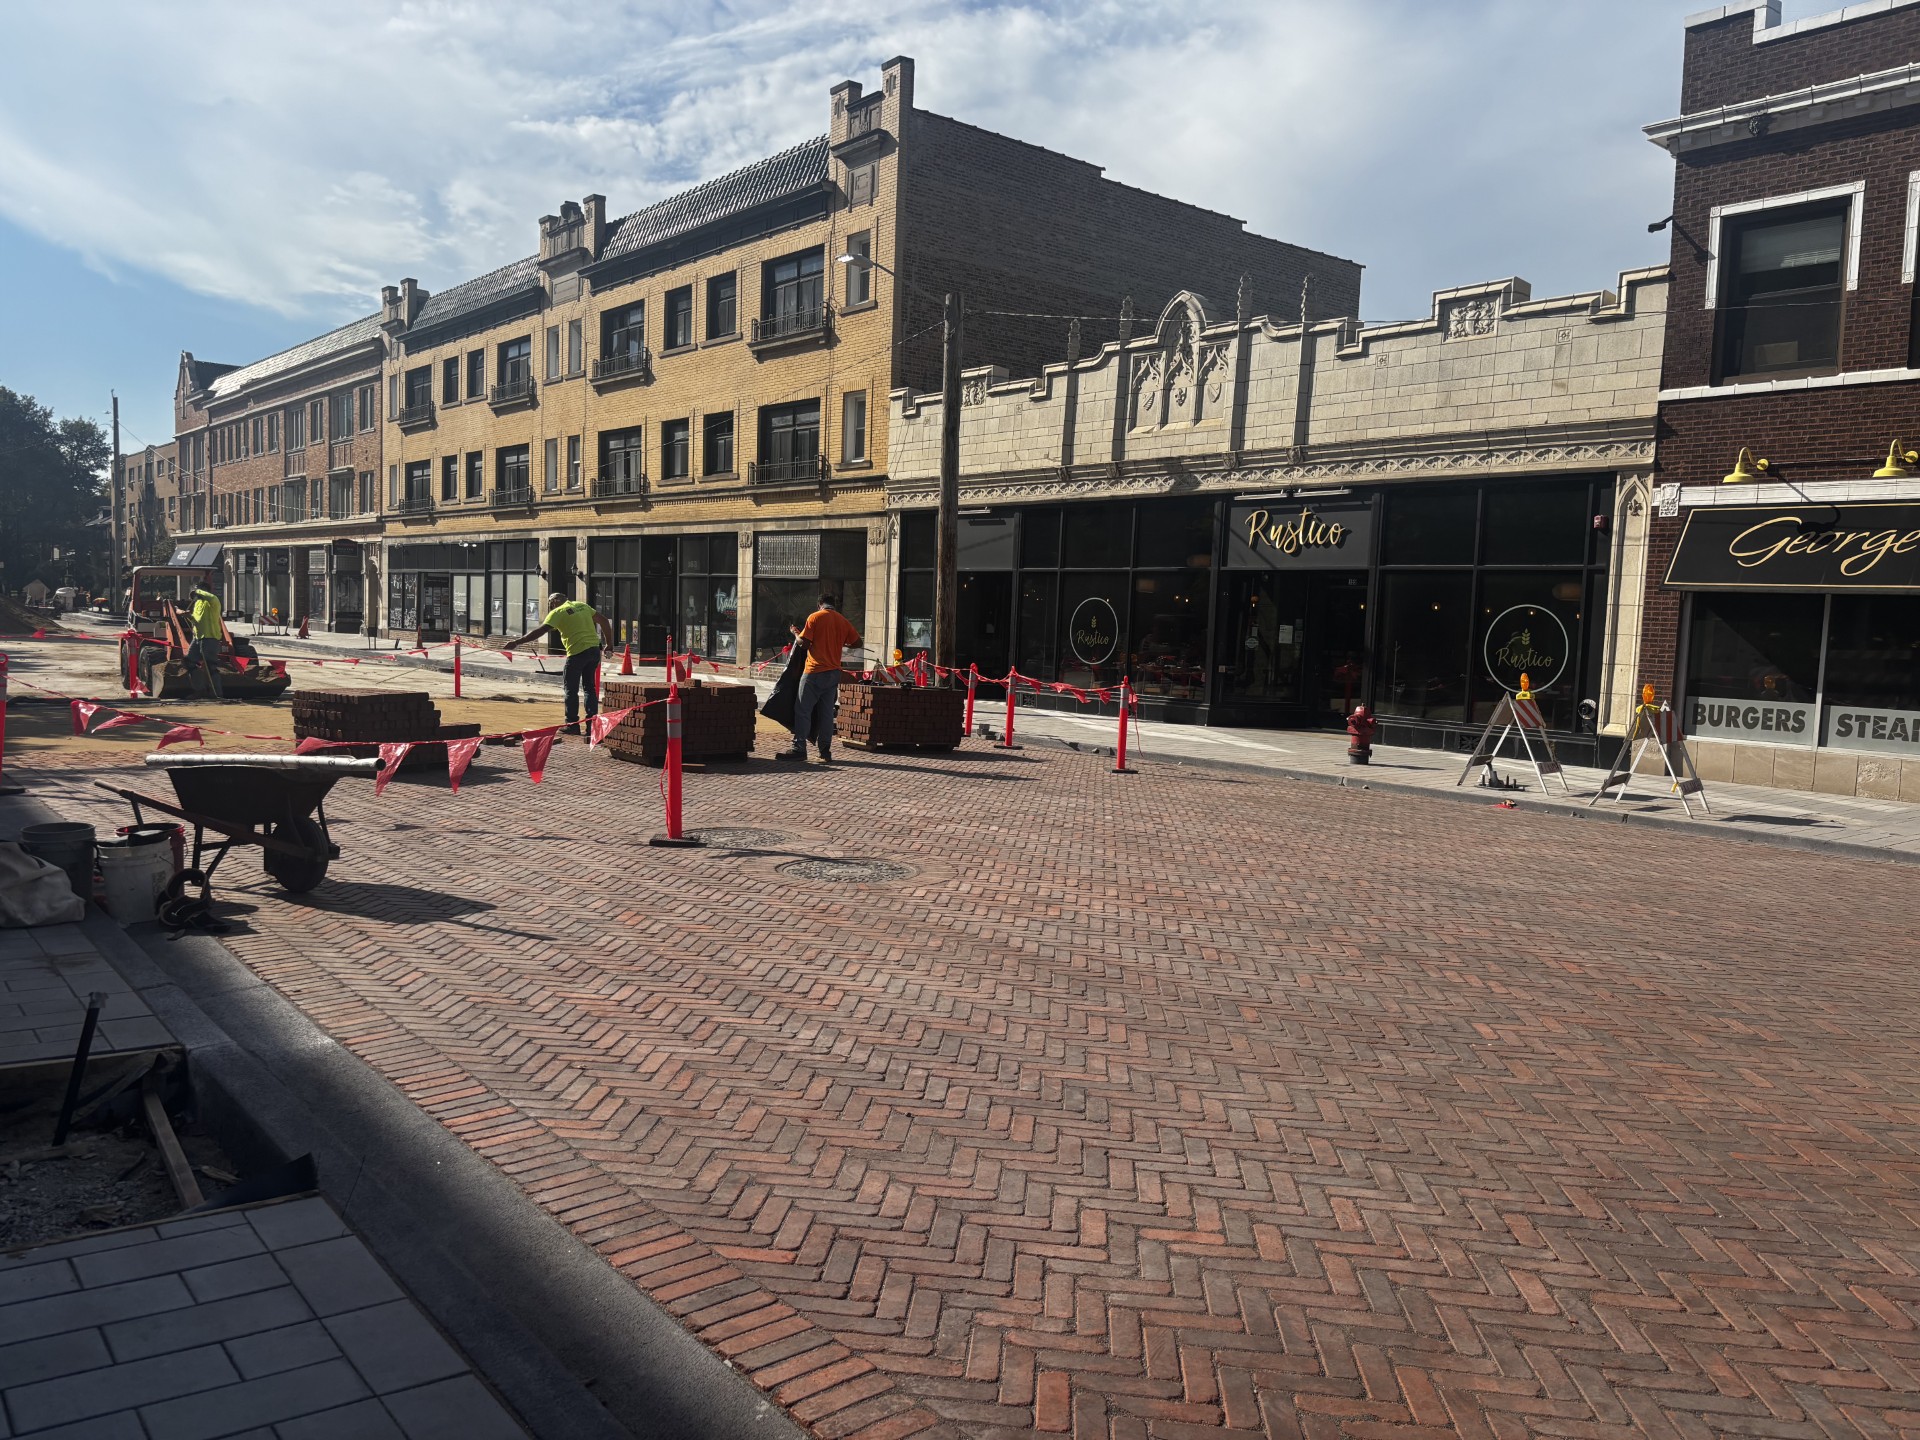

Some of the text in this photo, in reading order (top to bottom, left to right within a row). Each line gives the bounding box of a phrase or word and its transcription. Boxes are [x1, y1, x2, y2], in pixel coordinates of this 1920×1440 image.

[1244, 507, 1346, 554] Rustico
[1076, 629, 1110, 647] Rustico
[1495, 647, 1555, 671] Rustico
[1692, 703, 1807, 733] BURGERS
